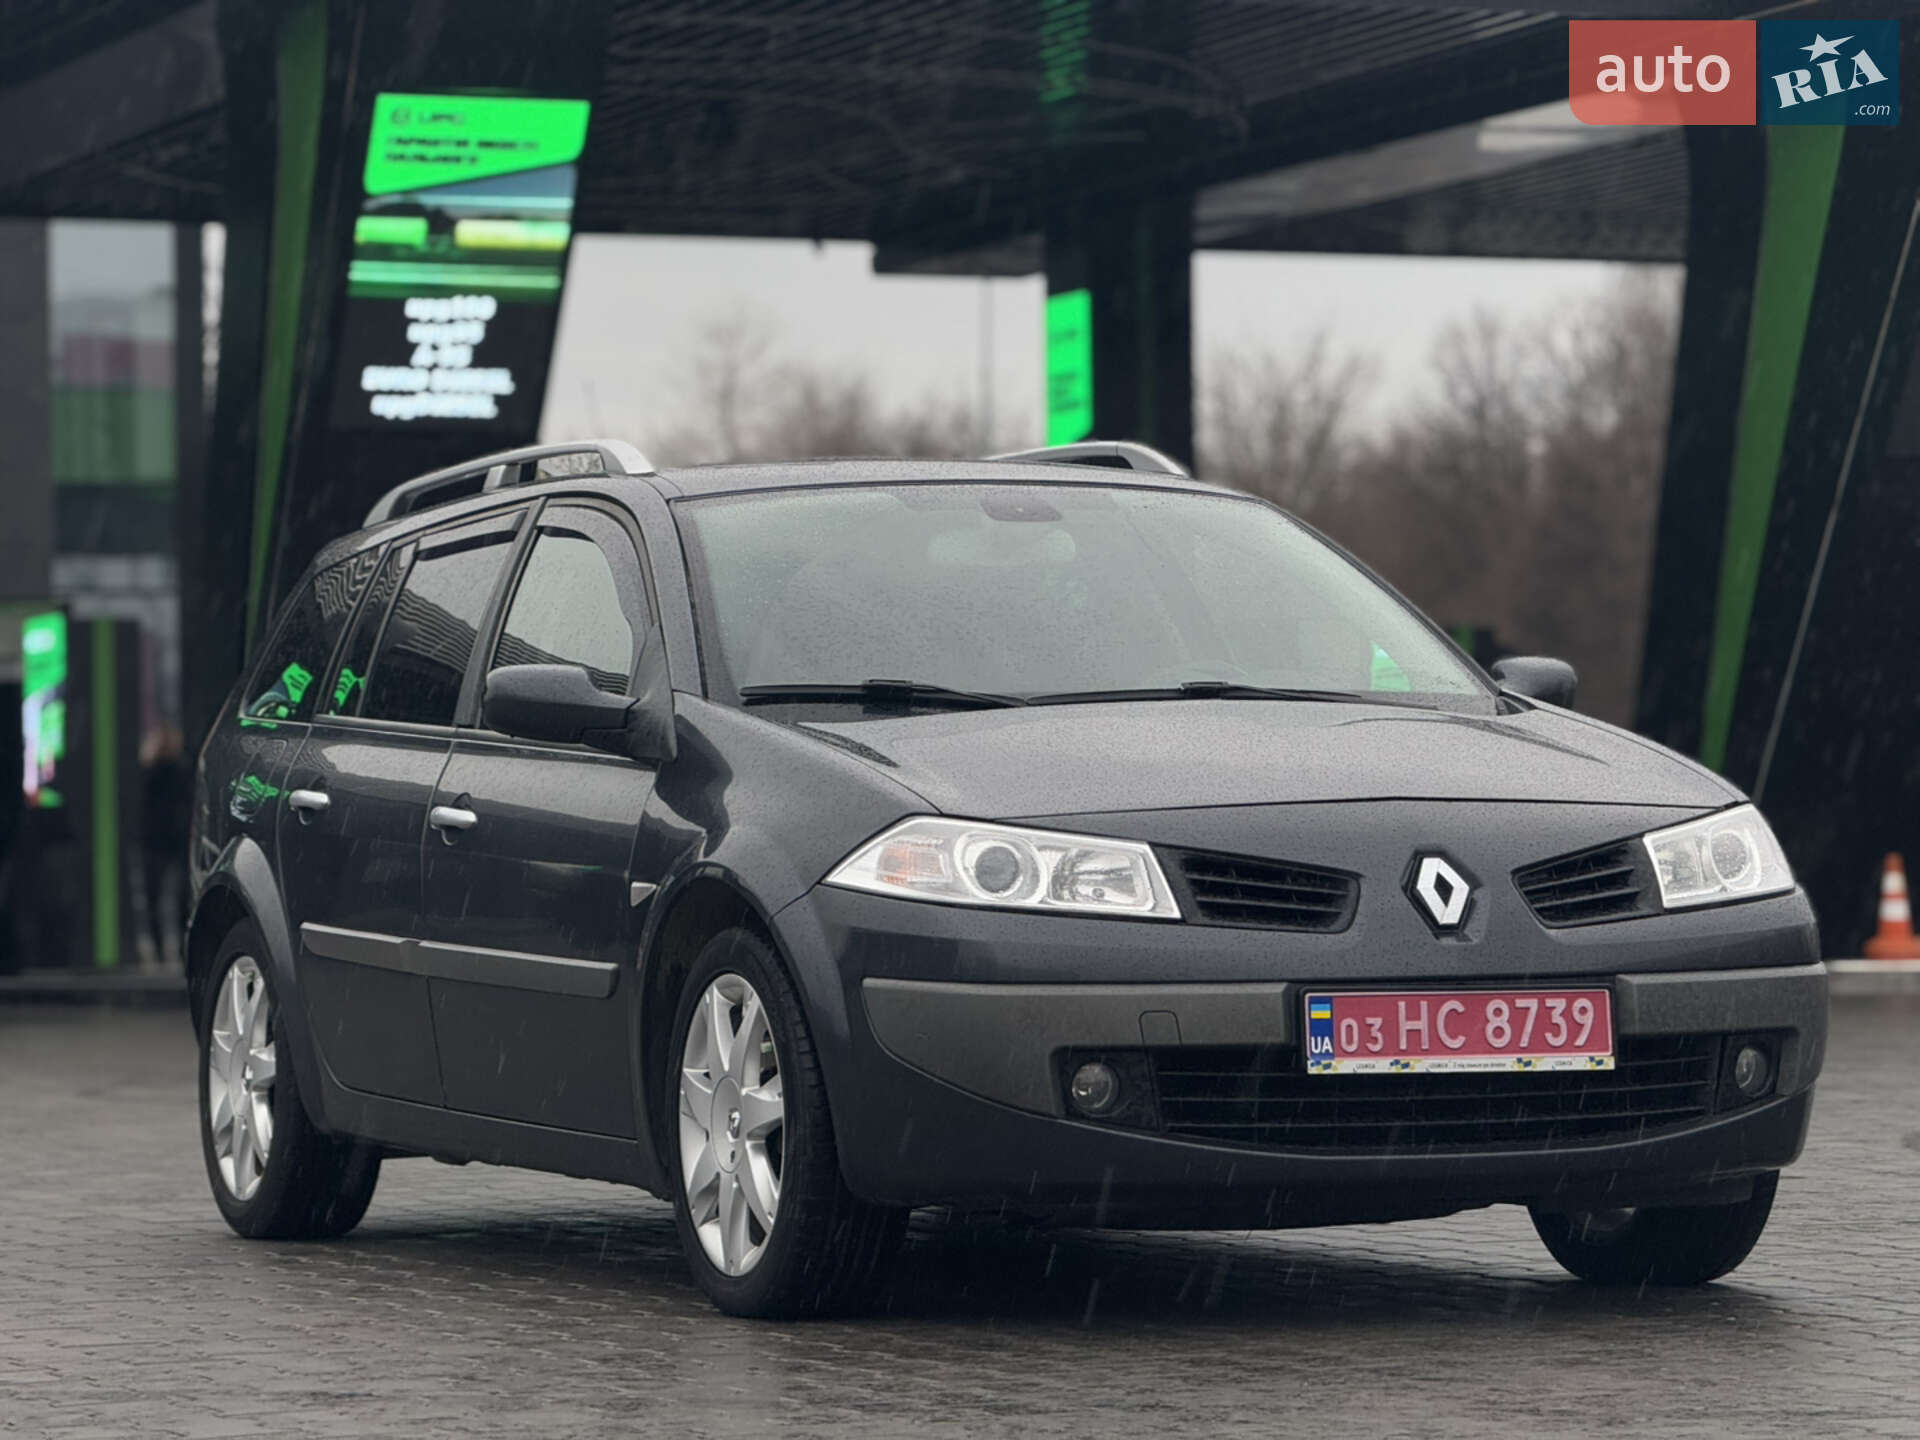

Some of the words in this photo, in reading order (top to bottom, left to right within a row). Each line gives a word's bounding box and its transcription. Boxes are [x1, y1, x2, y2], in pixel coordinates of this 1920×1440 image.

[1339, 1017, 1384, 1053] 03
[1397, 1000, 1467, 1050] HC
[1485, 997, 1595, 1049] 8739
[1310, 1036, 1333, 1054] UA
